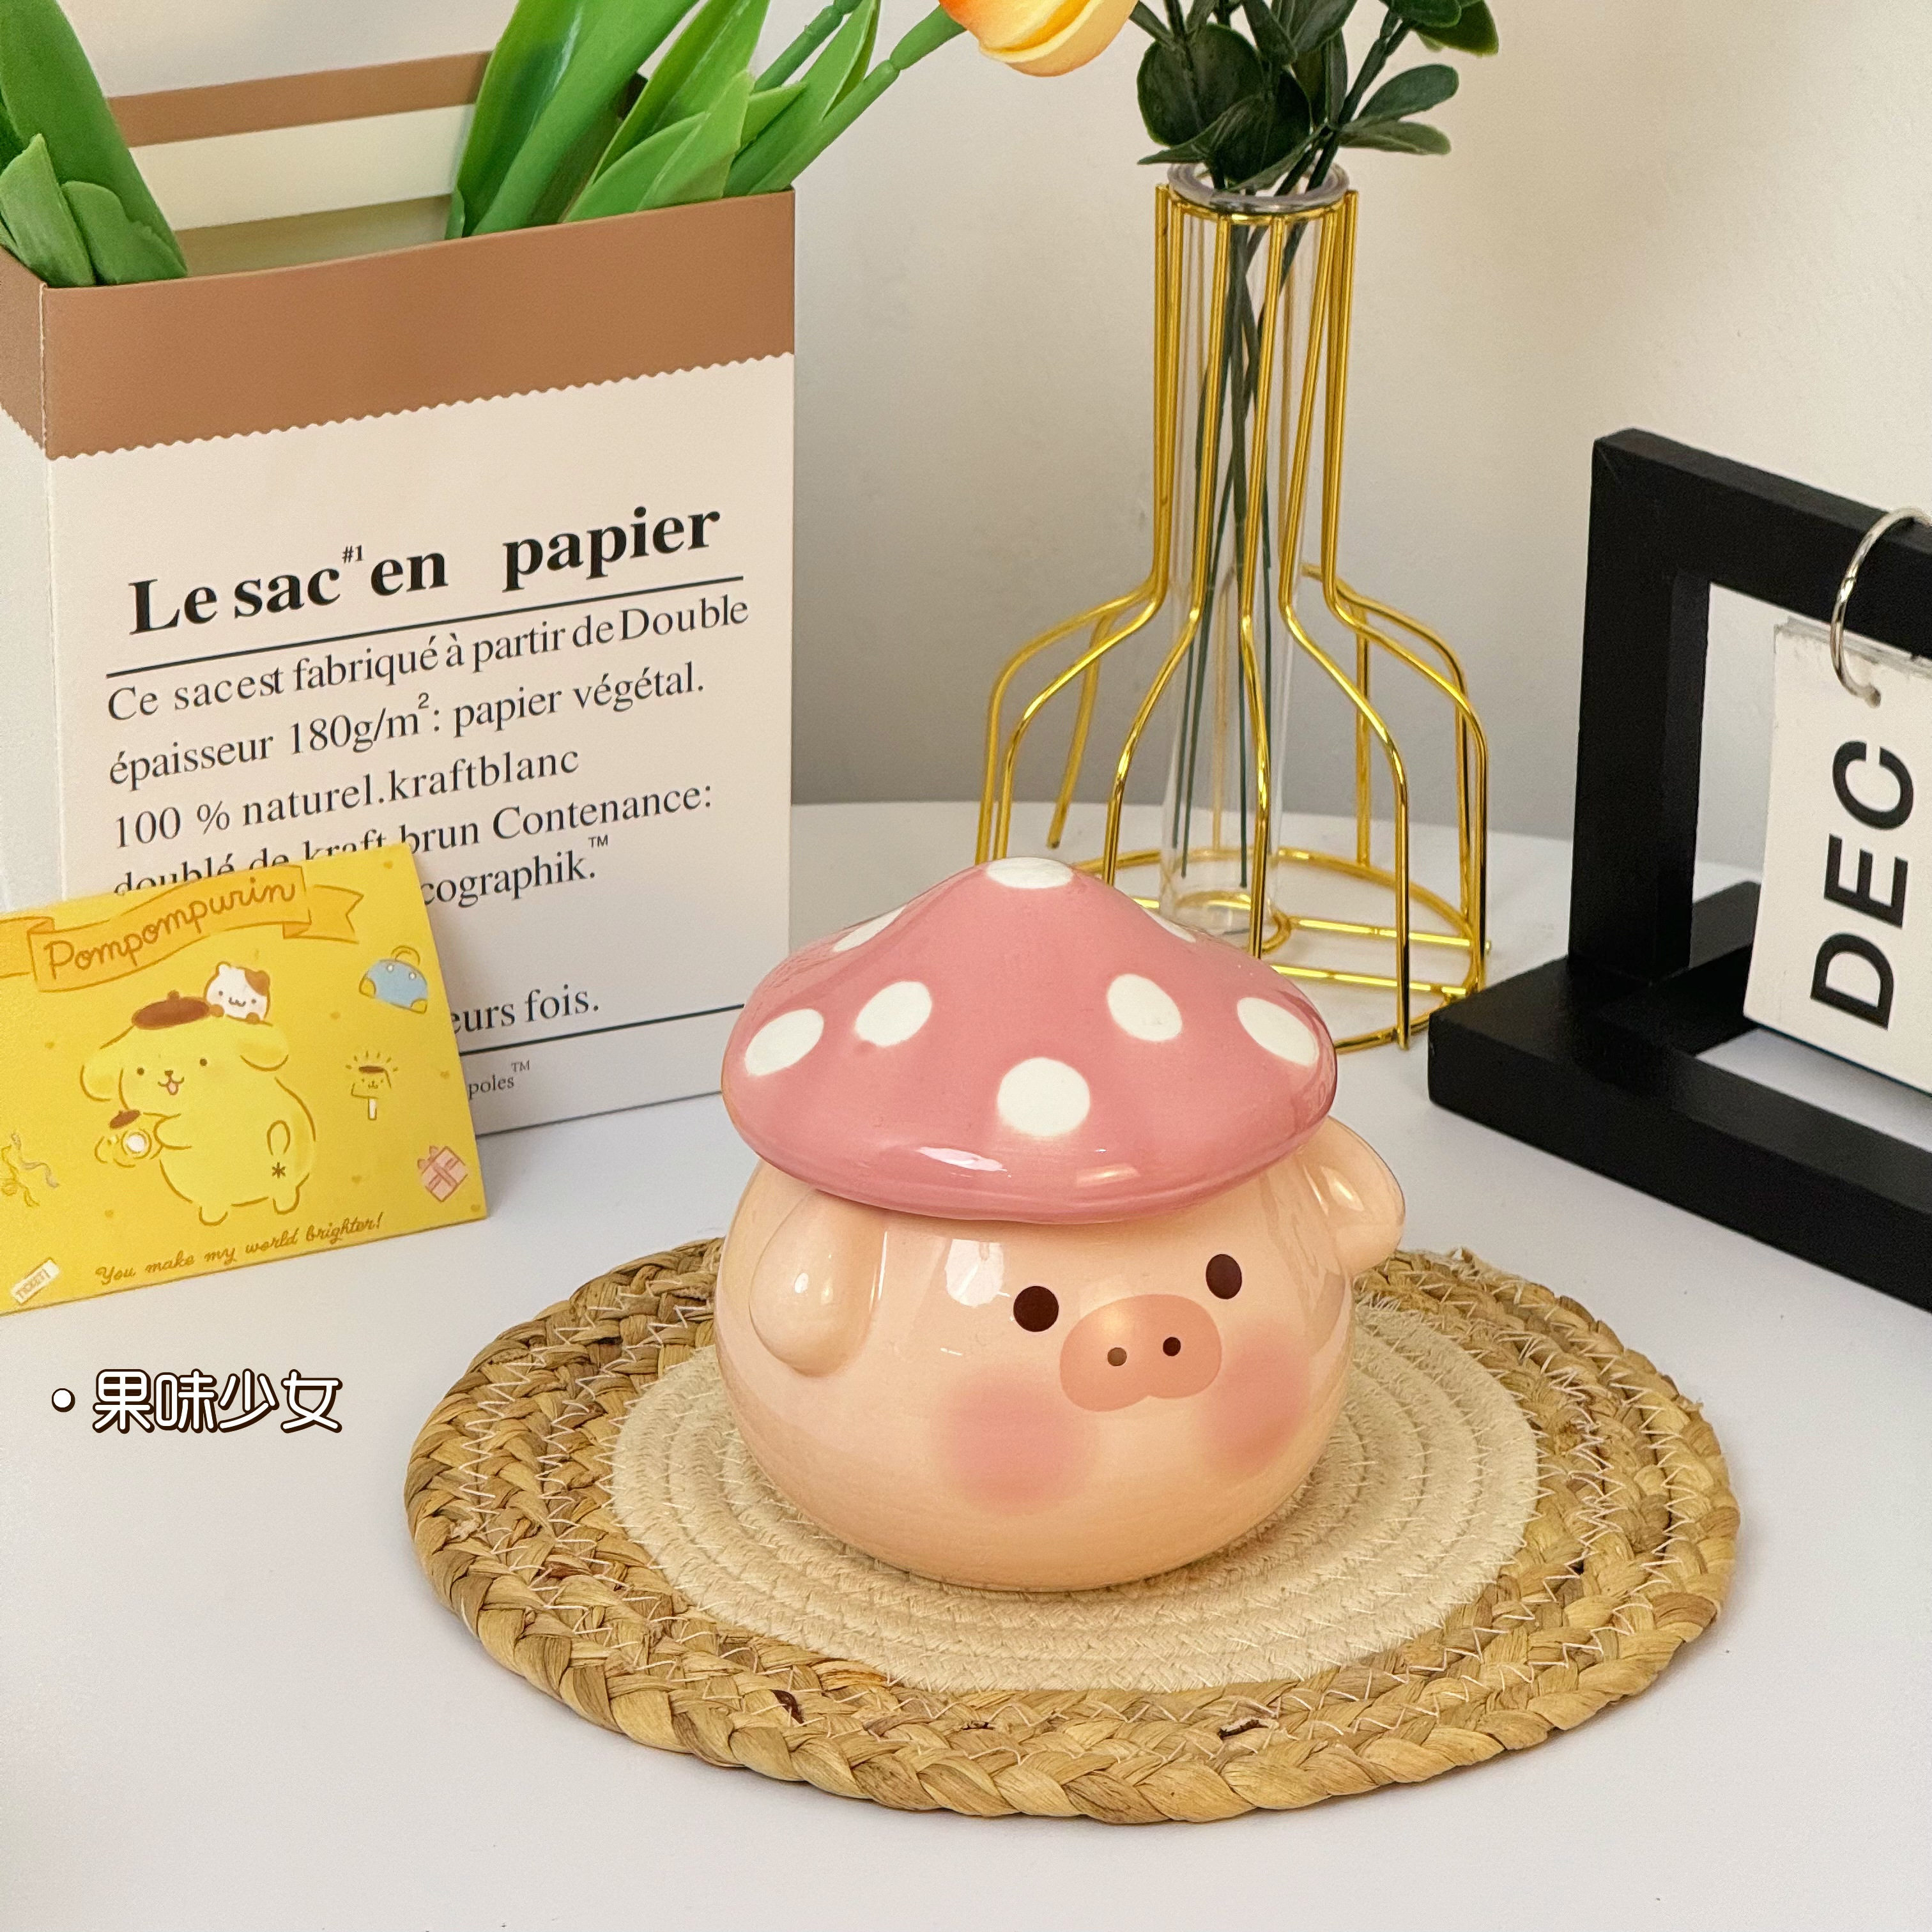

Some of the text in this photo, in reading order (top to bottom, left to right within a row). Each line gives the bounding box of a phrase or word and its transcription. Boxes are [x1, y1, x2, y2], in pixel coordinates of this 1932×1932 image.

[128, 579, 218, 636] Le
[371, 552, 448, 596] en
[502, 505, 721, 594] papier
[107, 686, 159, 721] Ce
[293, 635, 439, 691] fabriqué
[446, 633, 465, 668] à
[473, 621, 566, 673] partir
[109, 735, 274, 792] épaisseur
[453, 687, 562, 739] papier
[572, 661, 705, 713] végétal.
[116, 807, 181, 849] 100
[196, 801, 231, 835] %
[399, 822, 480, 855] brun
[493, 784, 711, 840] Contenance:
[43, 877, 296, 981] Pompompurin
[1809, 740, 1914, 1031] DEC
[524, 983, 599, 1023] fois.
[95, 1211, 384, 1285] You make my world brighter!
